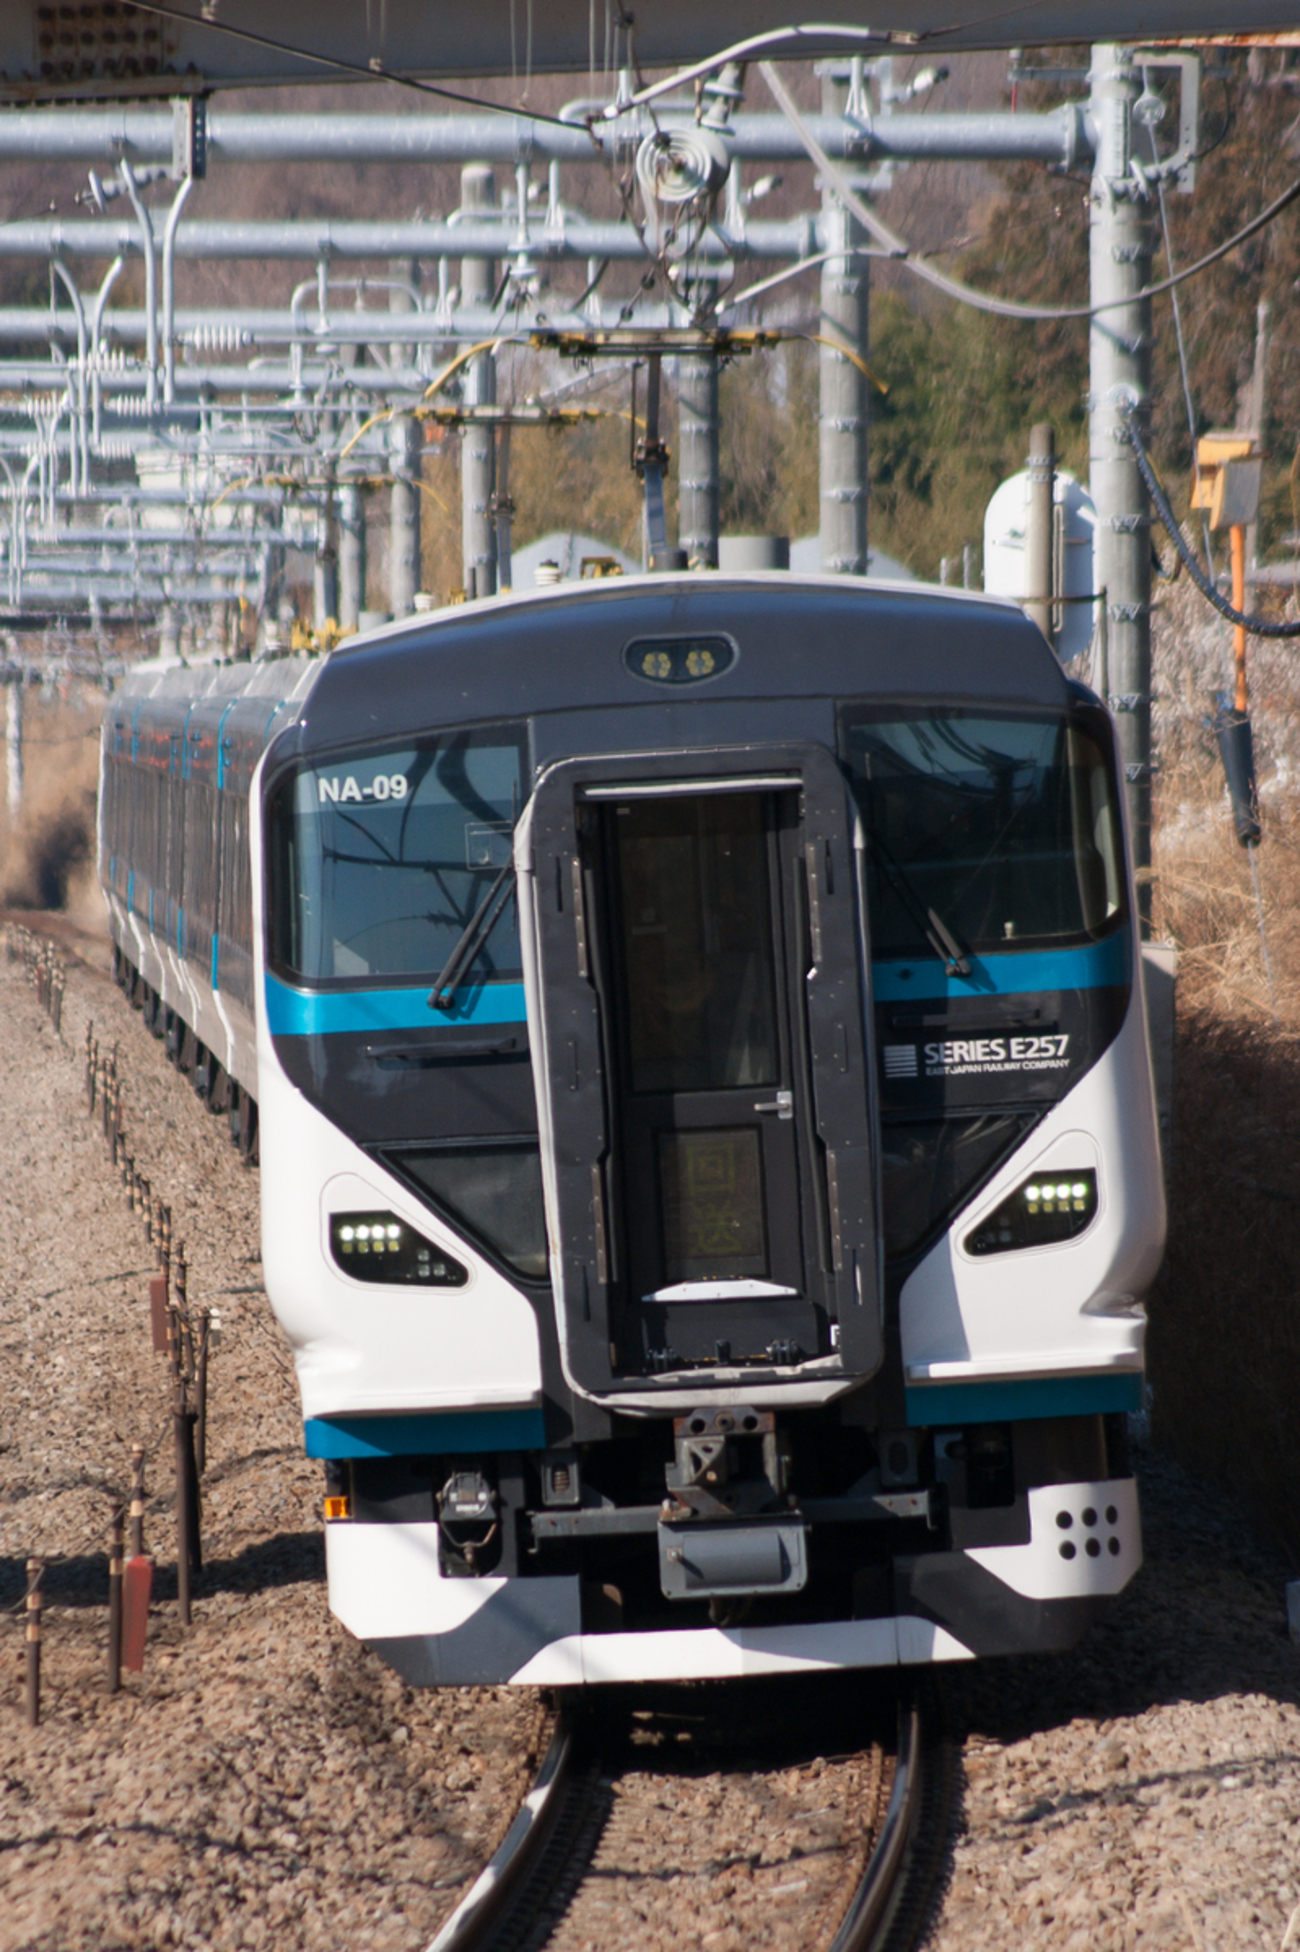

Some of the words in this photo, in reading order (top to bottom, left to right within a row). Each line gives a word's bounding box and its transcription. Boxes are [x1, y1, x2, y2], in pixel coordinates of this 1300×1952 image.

[318, 774, 408, 802] NA-09
[924, 1039, 1006, 1064] SERIES
[1009, 1034, 1070, 1059] E257
[925, 1065, 949, 1076] EAST
[950, 1064, 982, 1075] JAPAN
[983, 1061, 1021, 1072] RAILWAY
[1022, 1058, 1070, 1070] COMPANY
[686, 1142, 742, 1255] 回送
